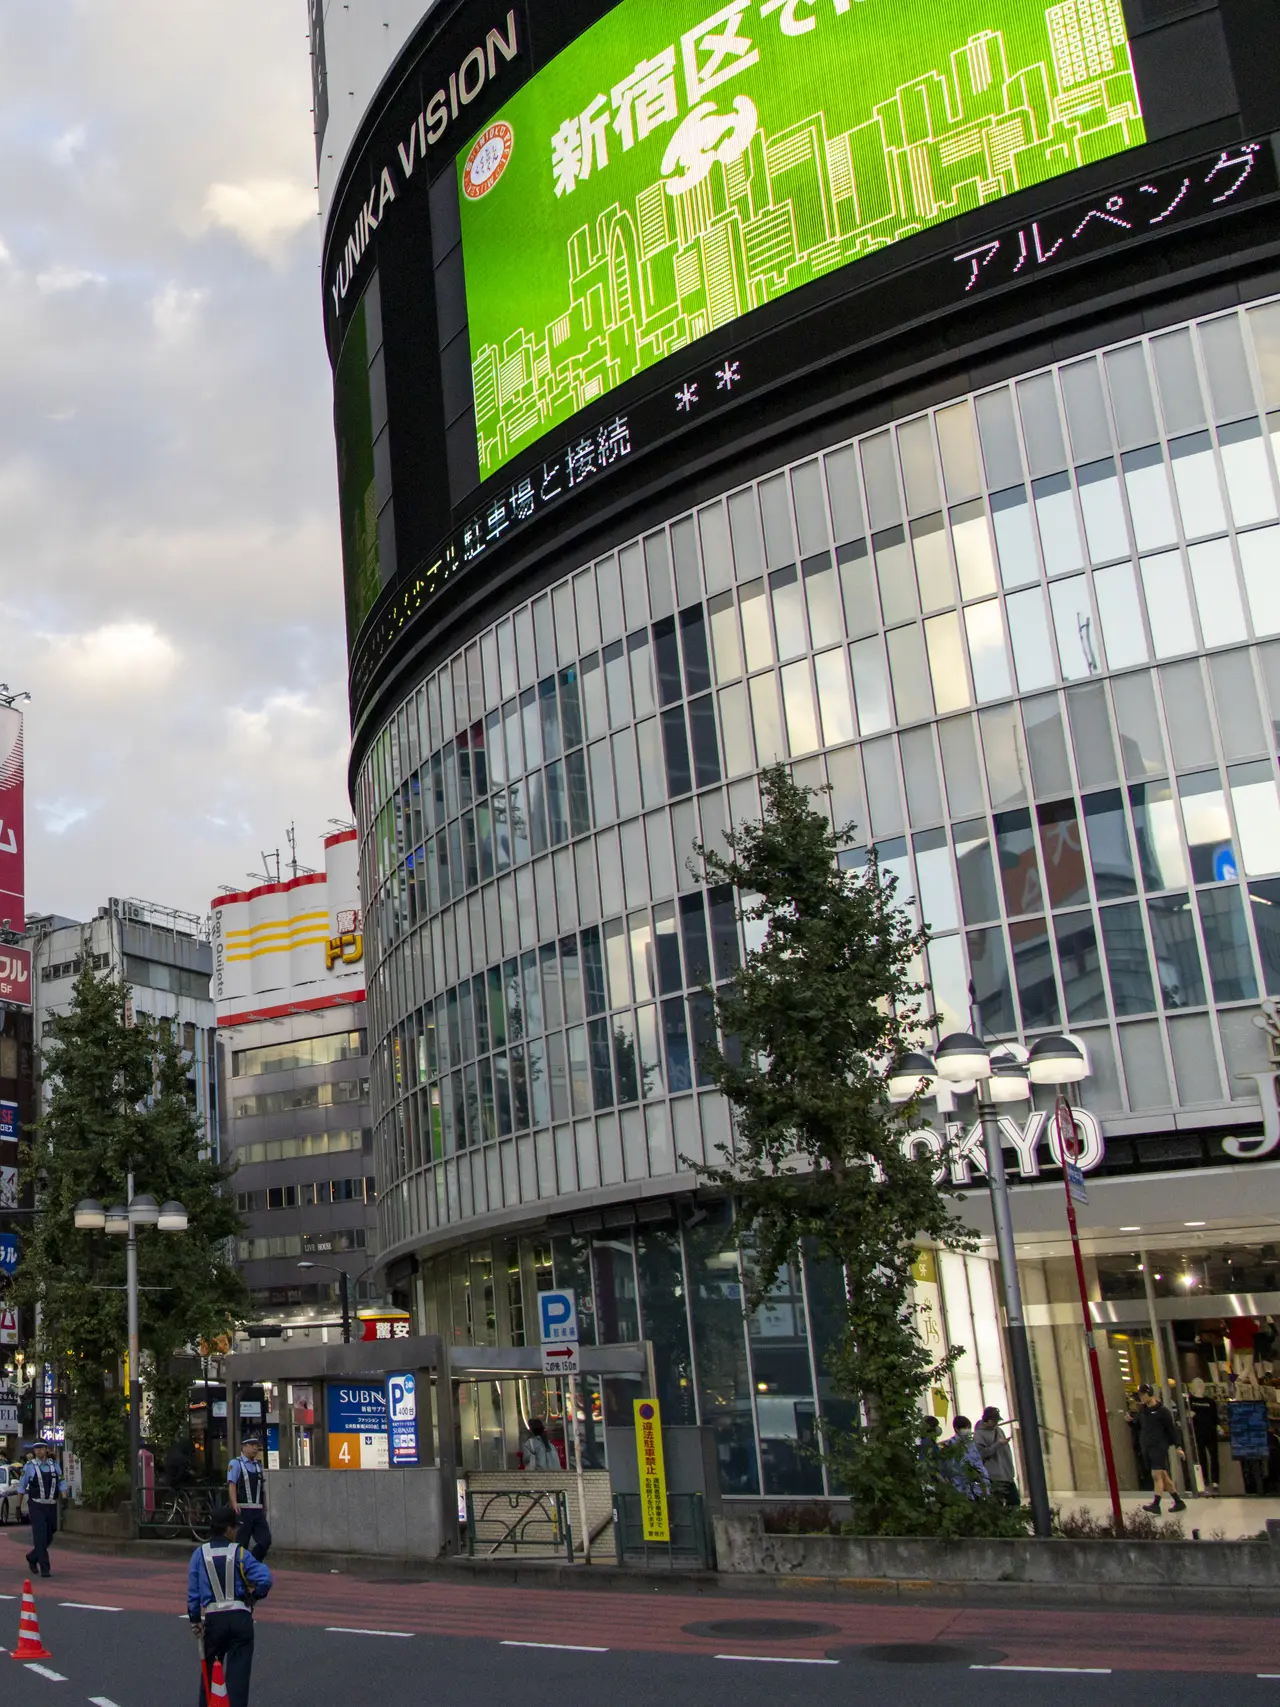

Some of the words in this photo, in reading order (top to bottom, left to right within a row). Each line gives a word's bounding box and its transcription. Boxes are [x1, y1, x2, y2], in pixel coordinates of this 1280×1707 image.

[332, 166, 396, 317] YUNIKA
[397, 9, 518, 179] VISION
[215, 909, 223, 939] Don
[216, 943, 224, 997] Quijote
[0, 982, 13, 994] 5F
[870, 1106, 1104, 1185] OKYO
[375, 1321, 410, 1339] 驚安
[541, 1294, 572, 1339] P
[545, 1361, 561, 1372] この先
[391, 1383, 404, 1417] P
[398, 1406, 414, 1416] 400台
[338, 1441, 351, 1464] 4
[642, 1421, 656, 1475] 違法駐車禁止
